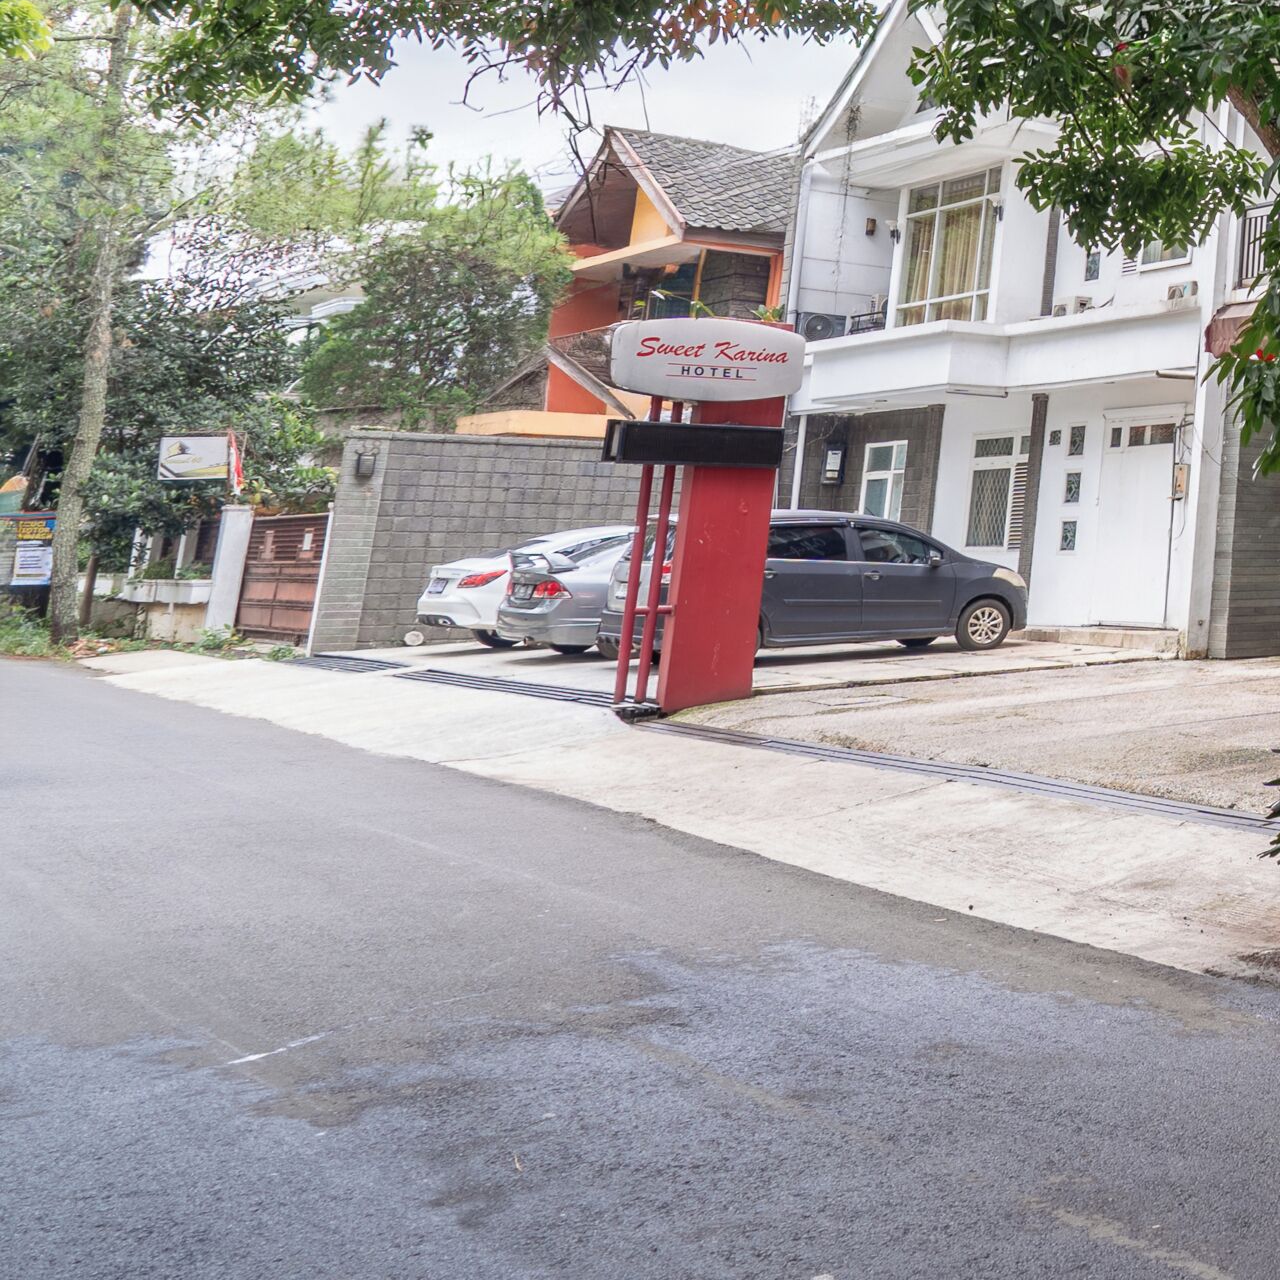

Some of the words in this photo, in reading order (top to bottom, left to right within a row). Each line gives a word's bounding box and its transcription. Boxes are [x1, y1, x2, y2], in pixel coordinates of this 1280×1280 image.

[636, 336, 706, 358] Sweet
[714, 341, 790, 364] Karina
[681, 365, 743, 379] HOTEL
